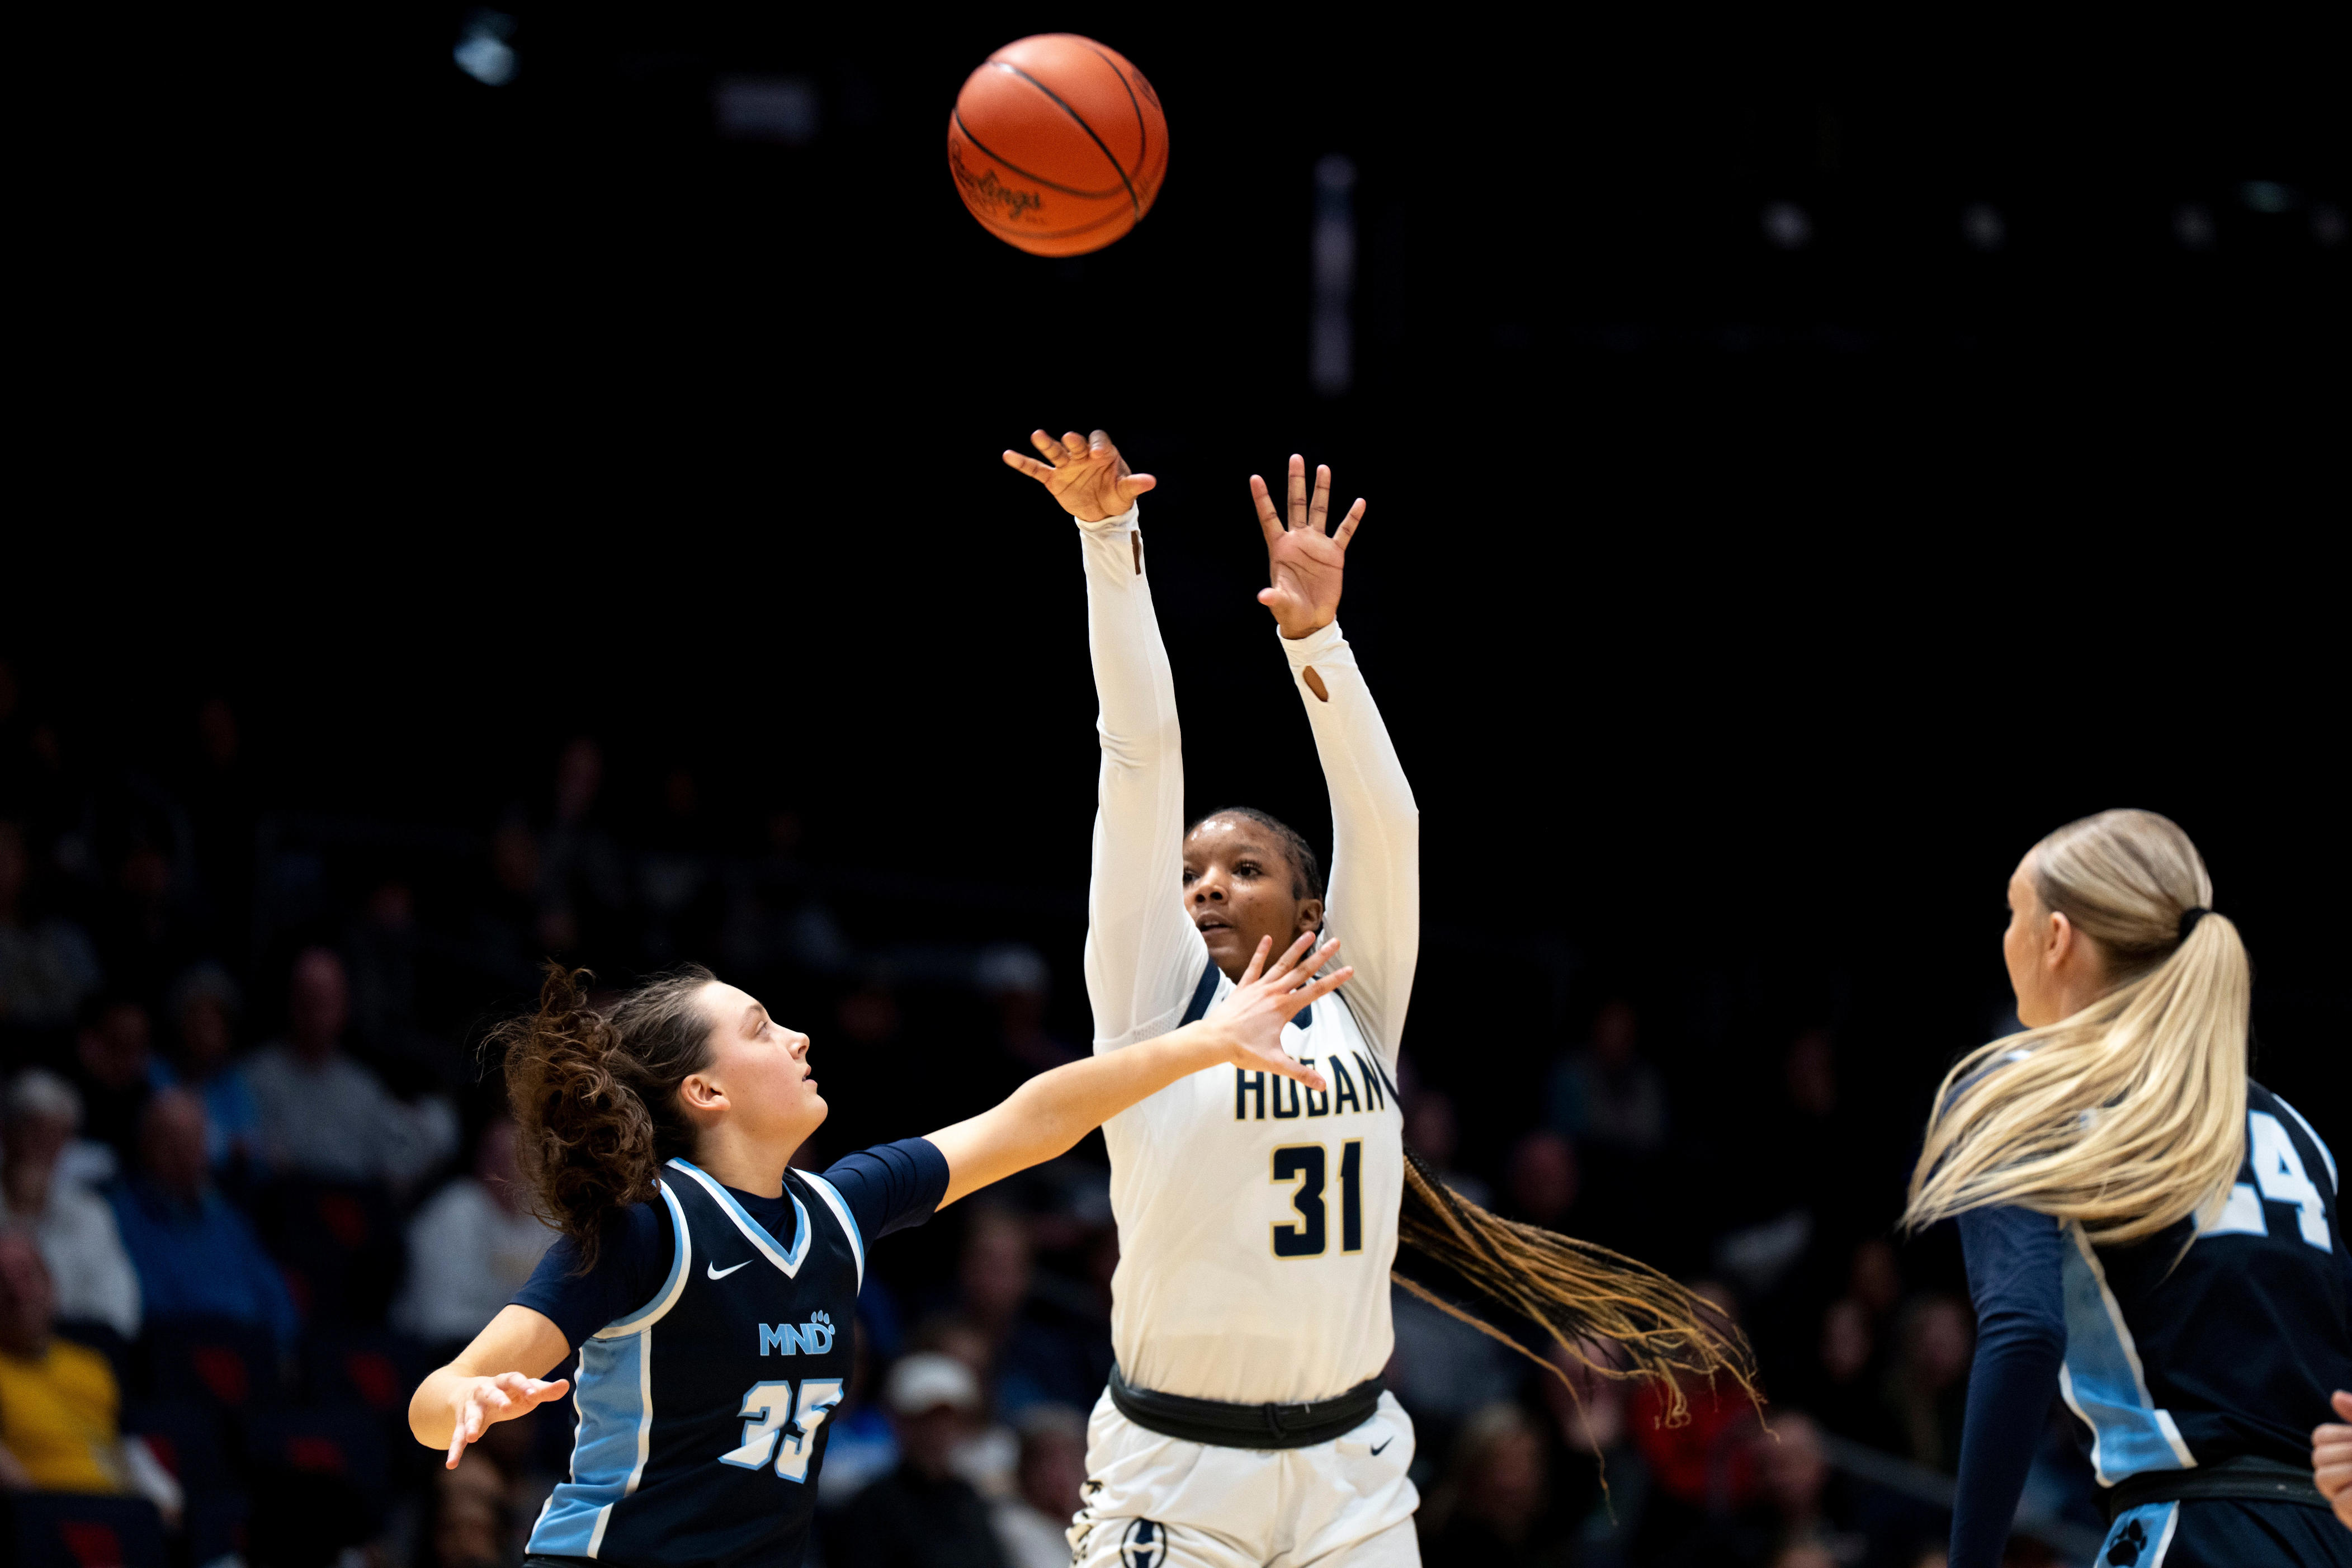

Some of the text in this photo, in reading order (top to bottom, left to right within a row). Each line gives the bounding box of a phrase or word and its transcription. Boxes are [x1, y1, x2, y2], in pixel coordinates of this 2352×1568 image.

[1234, 1051, 1386, 1122] HOBAN
[1269, 1136, 1364, 1262] 31
[758, 1323, 833, 1356] MND
